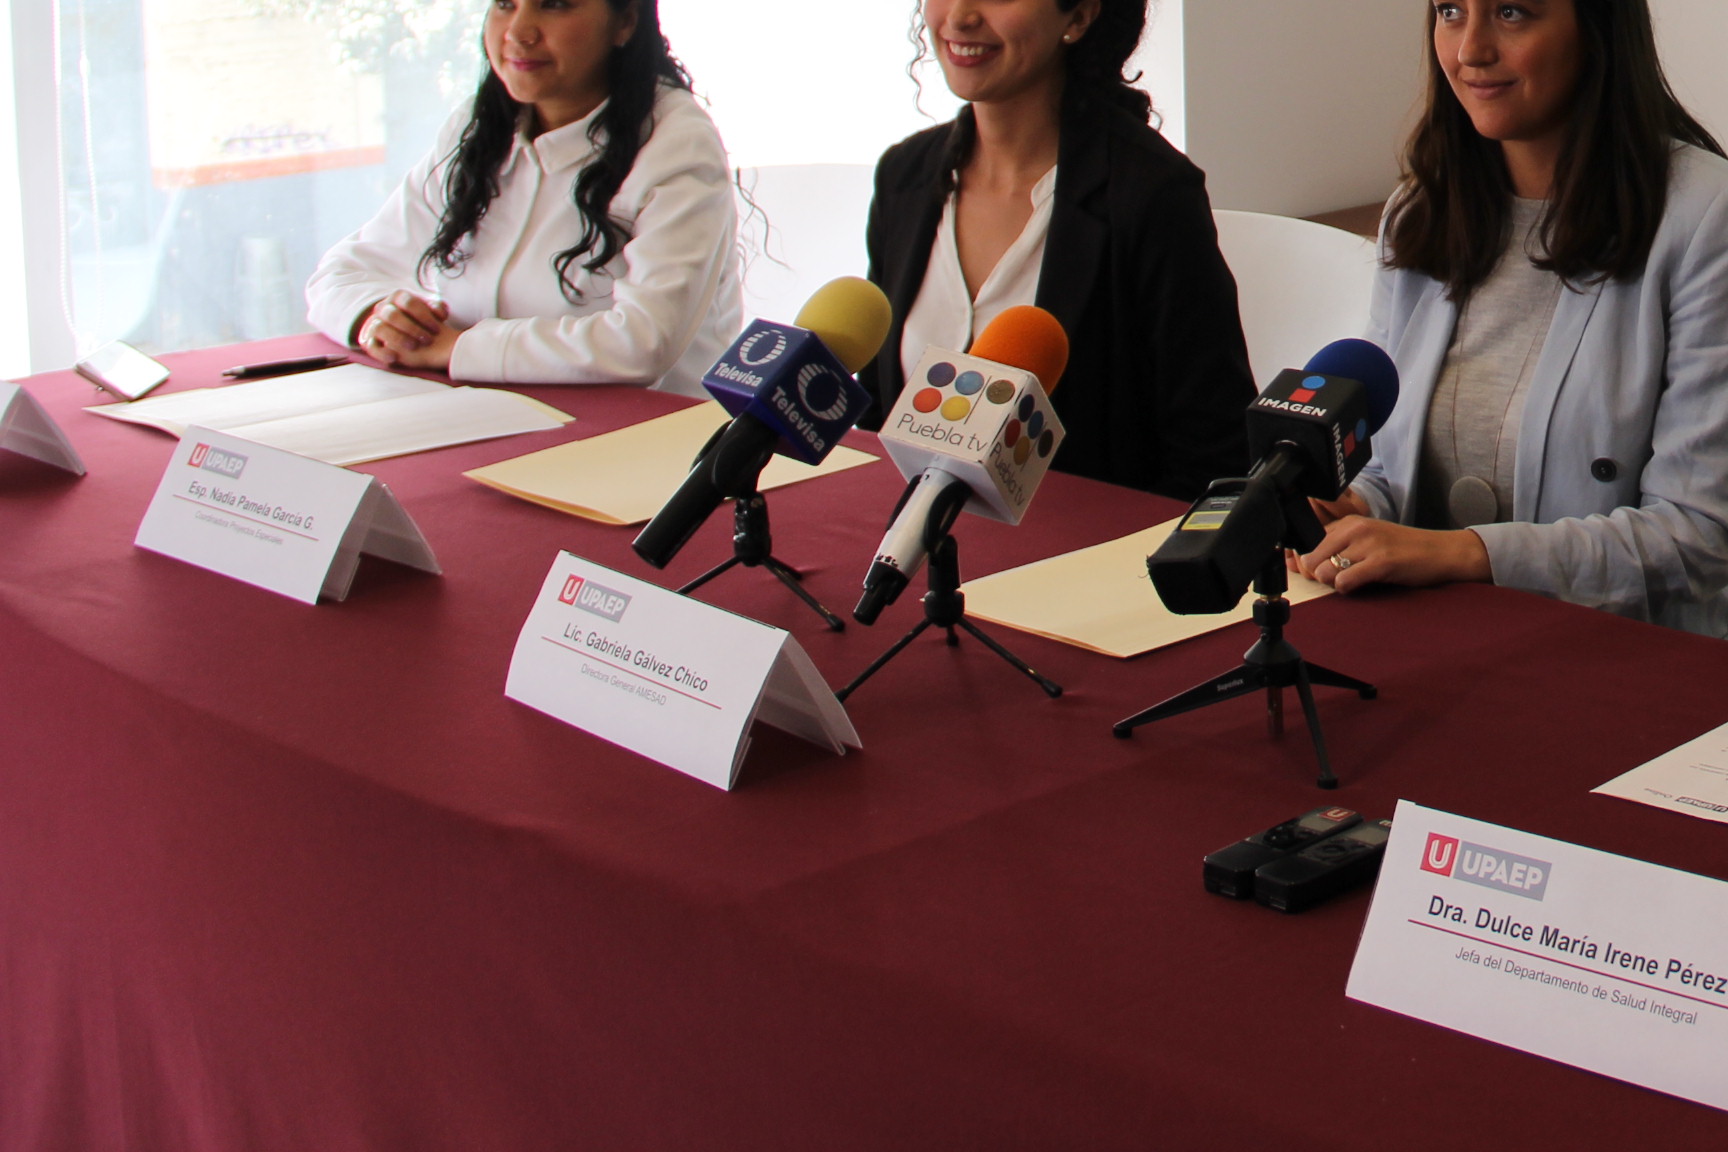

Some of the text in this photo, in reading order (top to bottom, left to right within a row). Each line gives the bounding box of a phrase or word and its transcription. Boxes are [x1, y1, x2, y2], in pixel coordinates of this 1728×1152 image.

[714, 362, 764, 388] Televisa
[771, 386, 826, 453] Televisa
[1258, 397, 1327, 418] IMAGEN
[897, 412, 988, 452] Puebla tv
[1332, 422, 1346, 488] IMAGEN
[206, 448, 245, 474] UPAEP
[990, 441, 1017, 495] Puebla
[188, 480, 315, 531] Esp. Nadia Pamela García G.
[581, 583, 626, 616] UPAEP
[563, 622, 709, 692] Lic. Gabriela Gálvez Chico
[609, 673, 636, 695] General
[1460, 850, 1543, 891] UPAEP
[1428, 894, 1469, 926] Dra.
[1475, 907, 1535, 944] Dulce
[1539, 925, 1599, 961] María
[1604, 942, 1660, 977] Irene
[1665, 957, 1728, 996] Pérez
[1454, 946, 1698, 1026] Jefa del Departamento de Salud Integral
